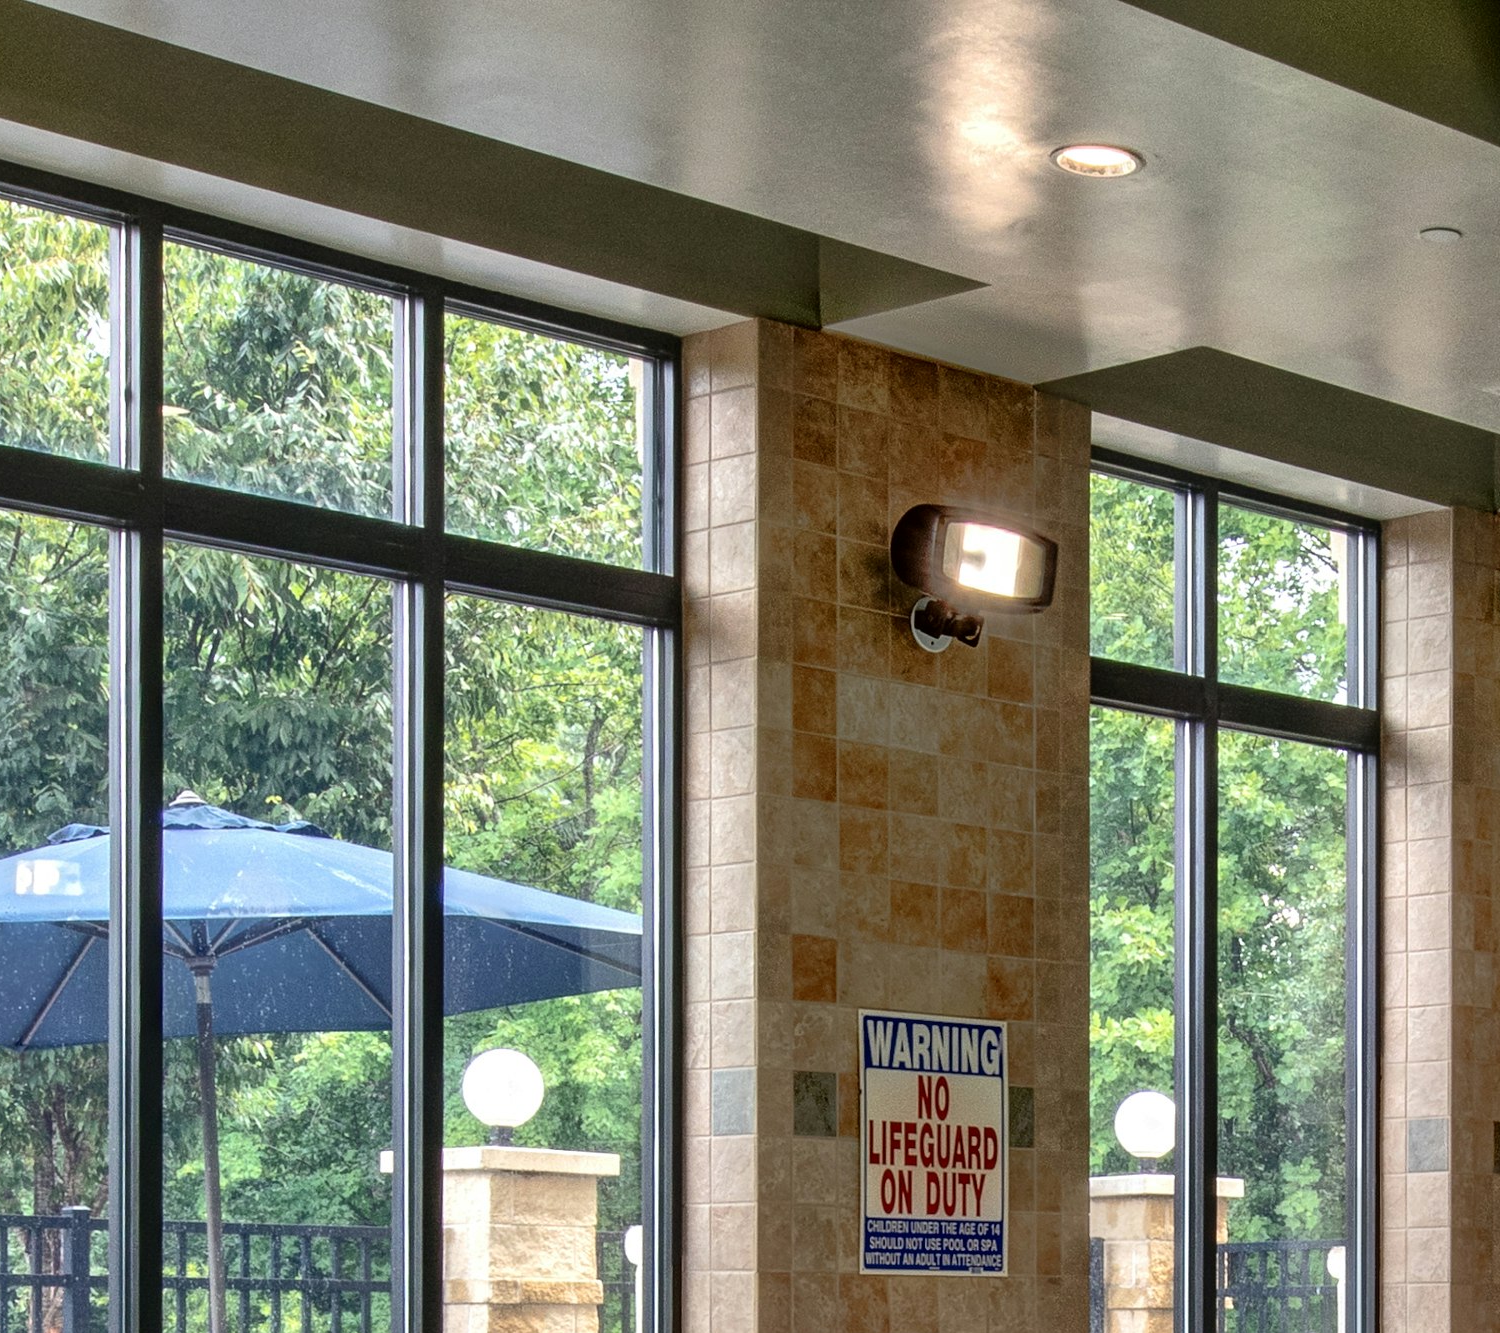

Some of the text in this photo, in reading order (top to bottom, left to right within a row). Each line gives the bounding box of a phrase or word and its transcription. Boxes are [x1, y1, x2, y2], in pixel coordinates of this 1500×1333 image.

[866, 1019, 1001, 1076] WARNING
[917, 1075, 950, 1121] NO
[869, 1120, 998, 1170] LIFEGUARD
[881, 1168, 986, 1217] ON DUTY
[867, 1219, 1000, 1236] CHILDREN UNDER THE AGE OF 14
[869, 1236, 998, 1252] SHOULD NOT USE POOL OR SPA
[865, 1252, 1002, 1267] WITHOUT AN ADULT IN ATTENDANCE
